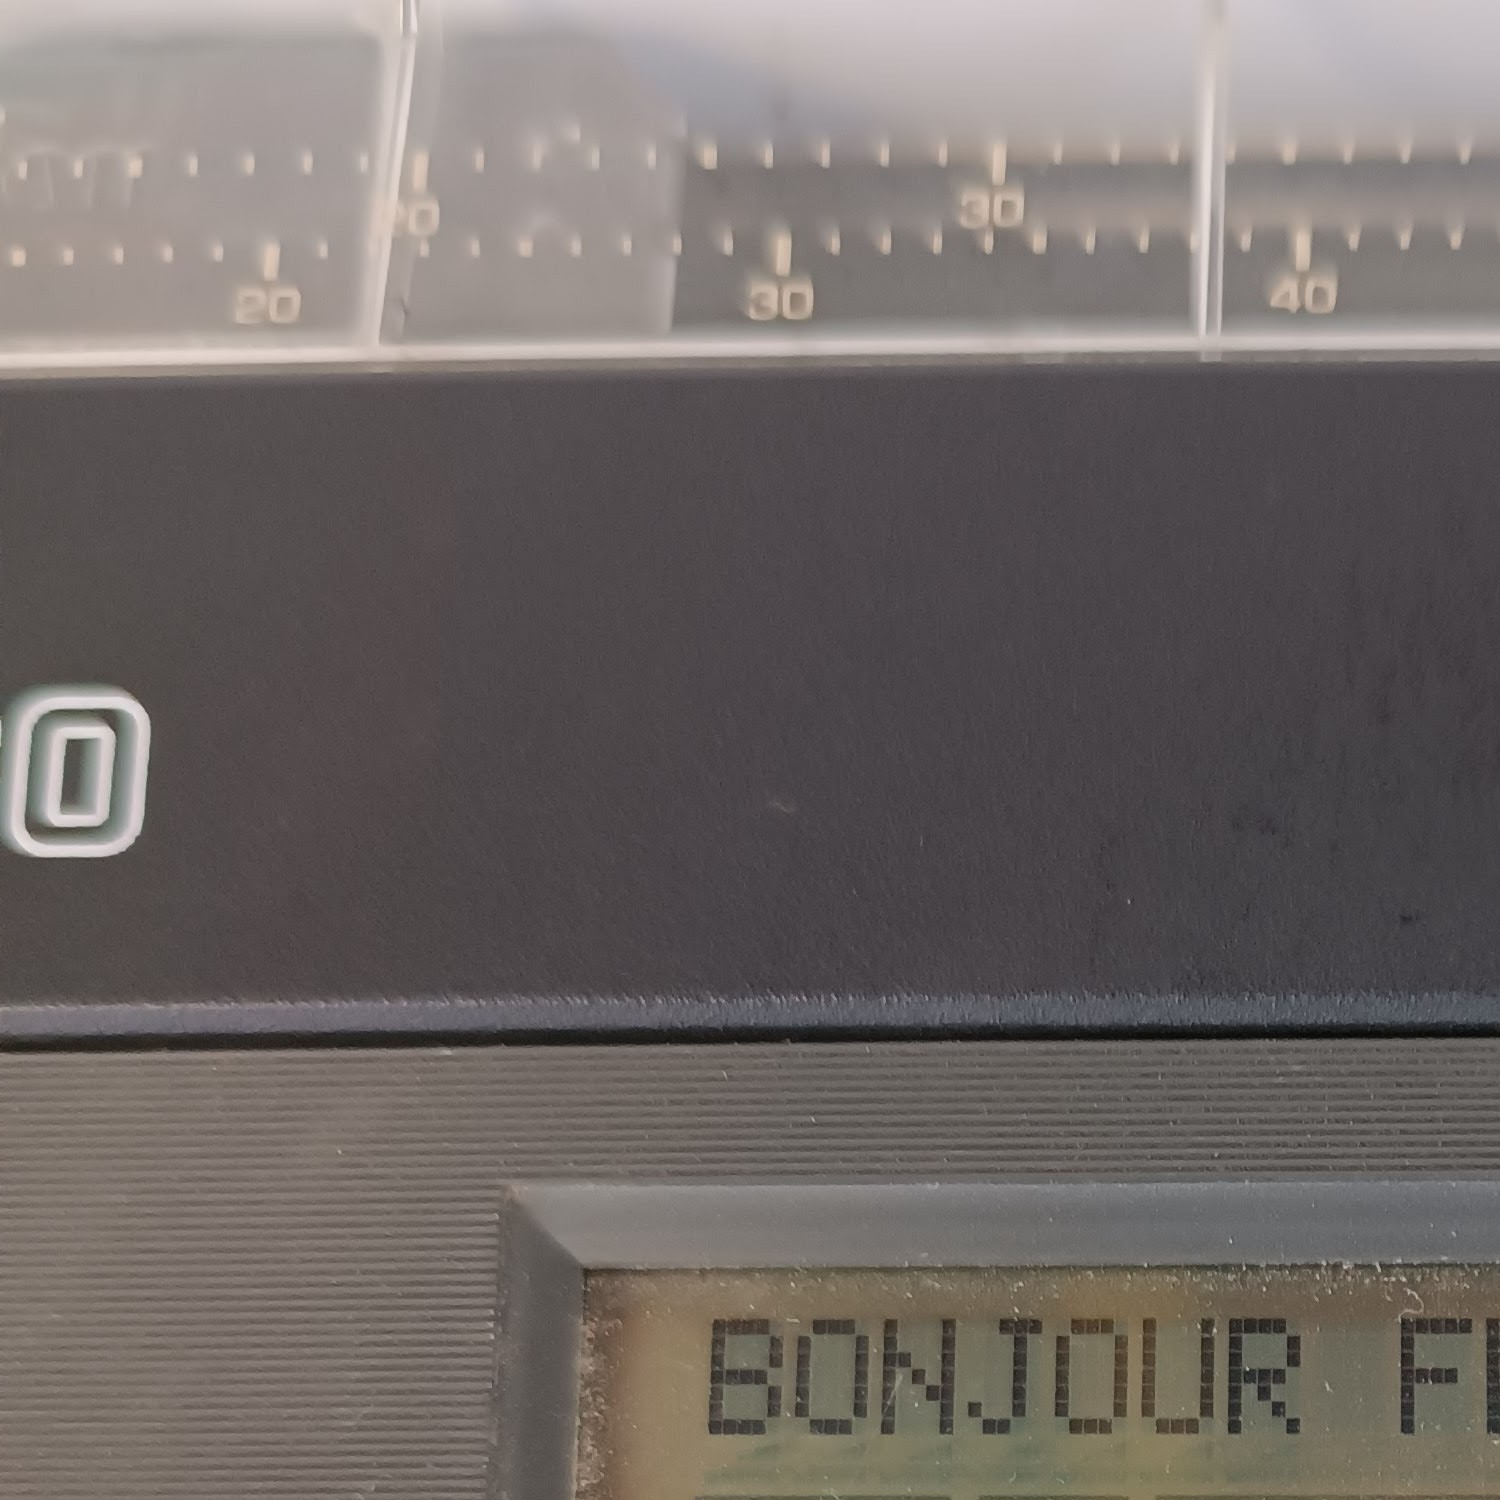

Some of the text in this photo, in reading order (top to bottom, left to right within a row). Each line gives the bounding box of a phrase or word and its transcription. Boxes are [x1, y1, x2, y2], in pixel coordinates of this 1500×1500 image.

[958, 186, 1024, 228] 30
[235, 286, 301, 324] 20
[748, 278, 815, 321] 30
[1269, 276, 1338, 314] 40
[708, 1317, 1301, 1435] BONJOUR
